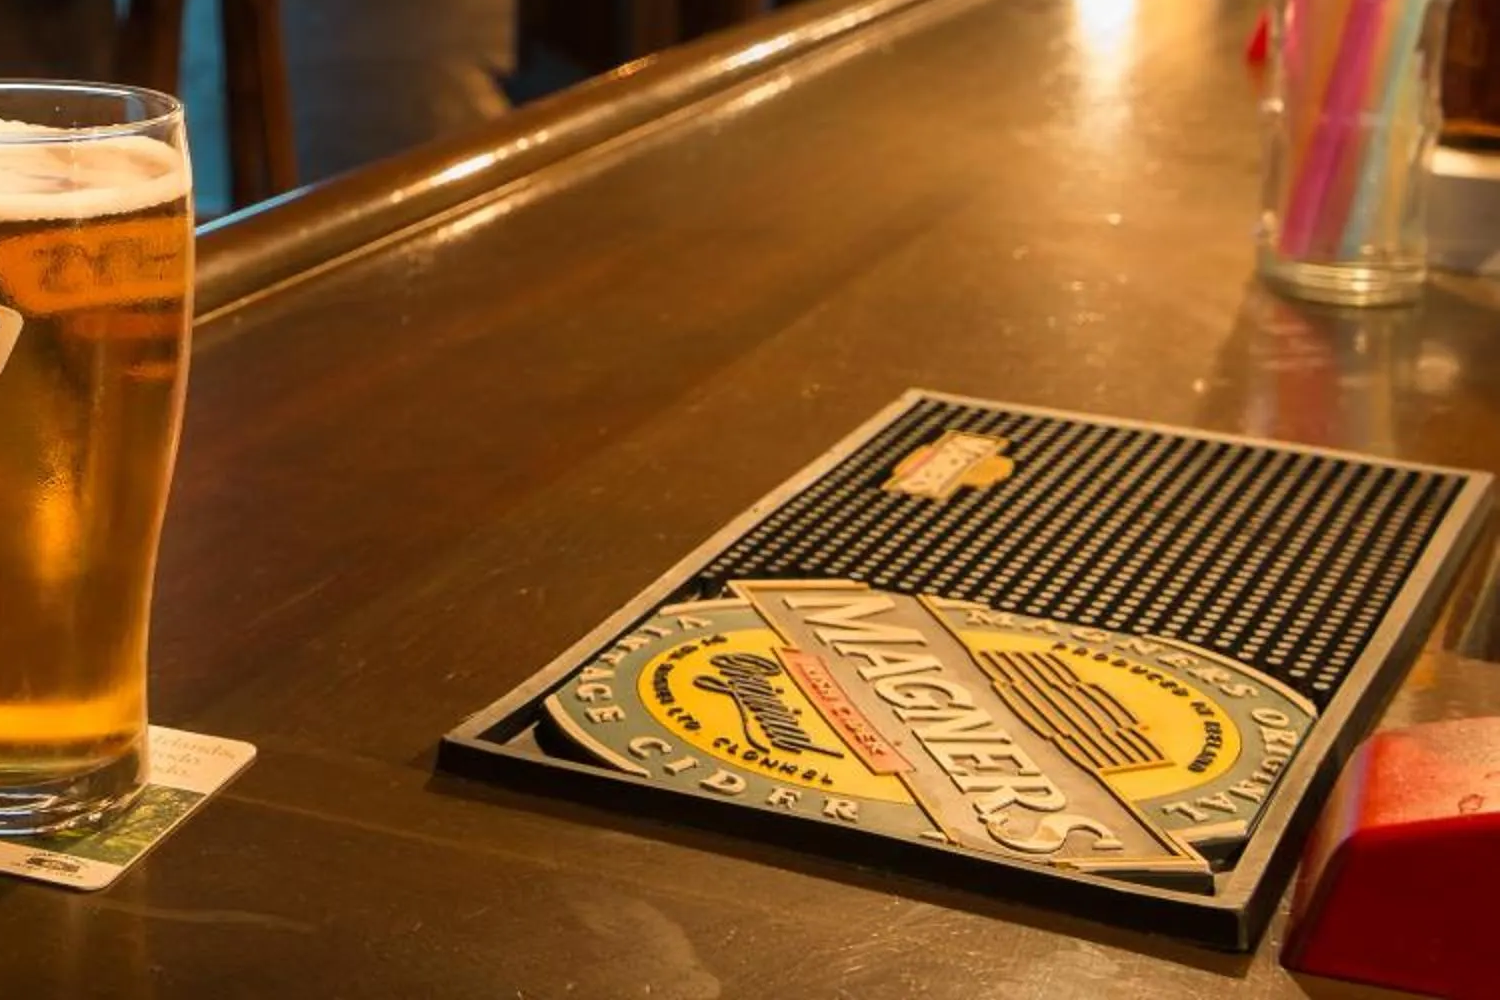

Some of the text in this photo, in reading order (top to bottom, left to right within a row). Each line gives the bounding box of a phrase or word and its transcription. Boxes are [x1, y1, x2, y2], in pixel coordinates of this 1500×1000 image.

[575, 614, 859, 822] VINTAGE CIDER
[692, 653, 845, 755] Original
[781, 594, 1124, 855] MAGNERS
[965, 609, 1299, 822] MAGNERS ORIGINAL
